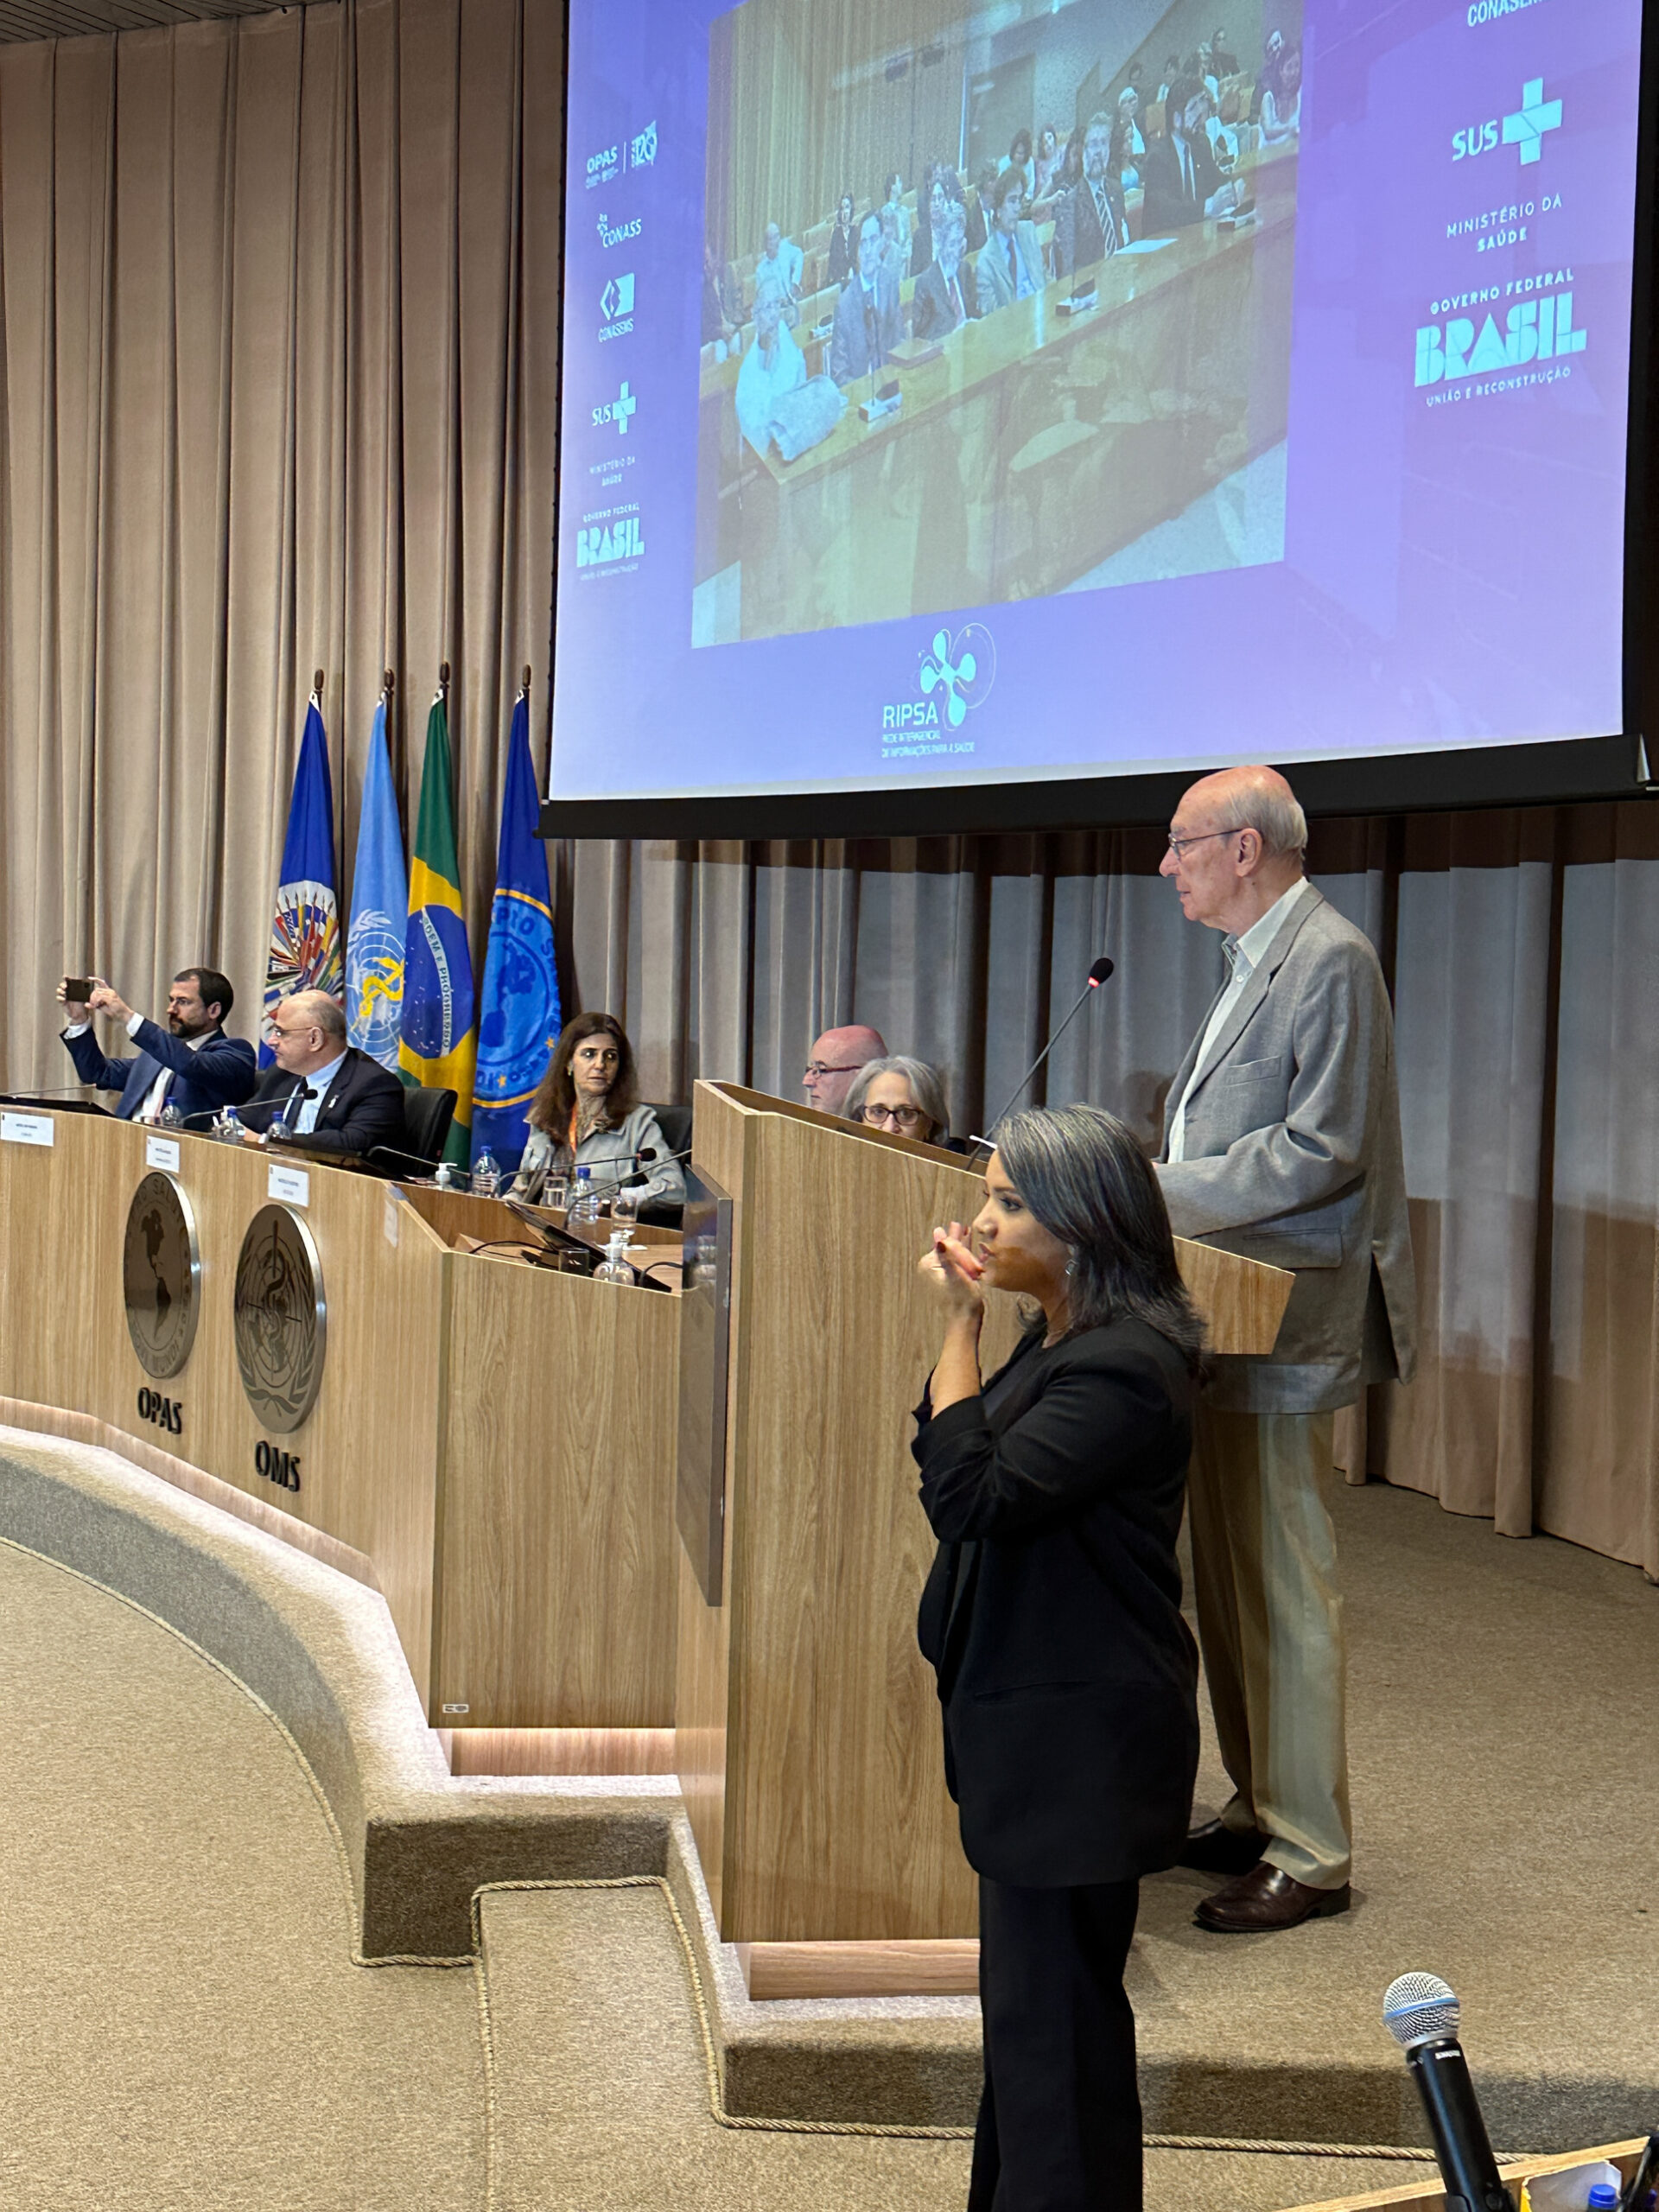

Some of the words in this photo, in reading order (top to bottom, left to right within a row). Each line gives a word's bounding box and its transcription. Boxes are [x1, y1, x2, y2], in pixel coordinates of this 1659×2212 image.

[587, 145, 618, 174] OPAS
[1452, 119, 1498, 162] SUS
[602, 219, 642, 248] CONASS
[1446, 204, 1535, 238] MINISTÉRIO
[1541, 193, 1562, 213] DA
[1477, 226, 1528, 252] SAÚDE
[1429, 286, 1500, 315] GOVERNO
[1506, 268, 1574, 296] FEDERAL
[1414, 290, 1587, 388] BRASIL
[1427, 388, 1461, 408] UNIÃO
[1465, 387, 1471, 399] E
[1476, 365, 1572, 397] RECONSTRUÇÃO
[592, 404, 612, 426] SUS
[576, 517, 645, 568] BRASIL
[882, 701, 938, 728] RIPSA
[137, 1387, 183, 1434] OPAS
[255, 1440, 301, 1492] OMS
